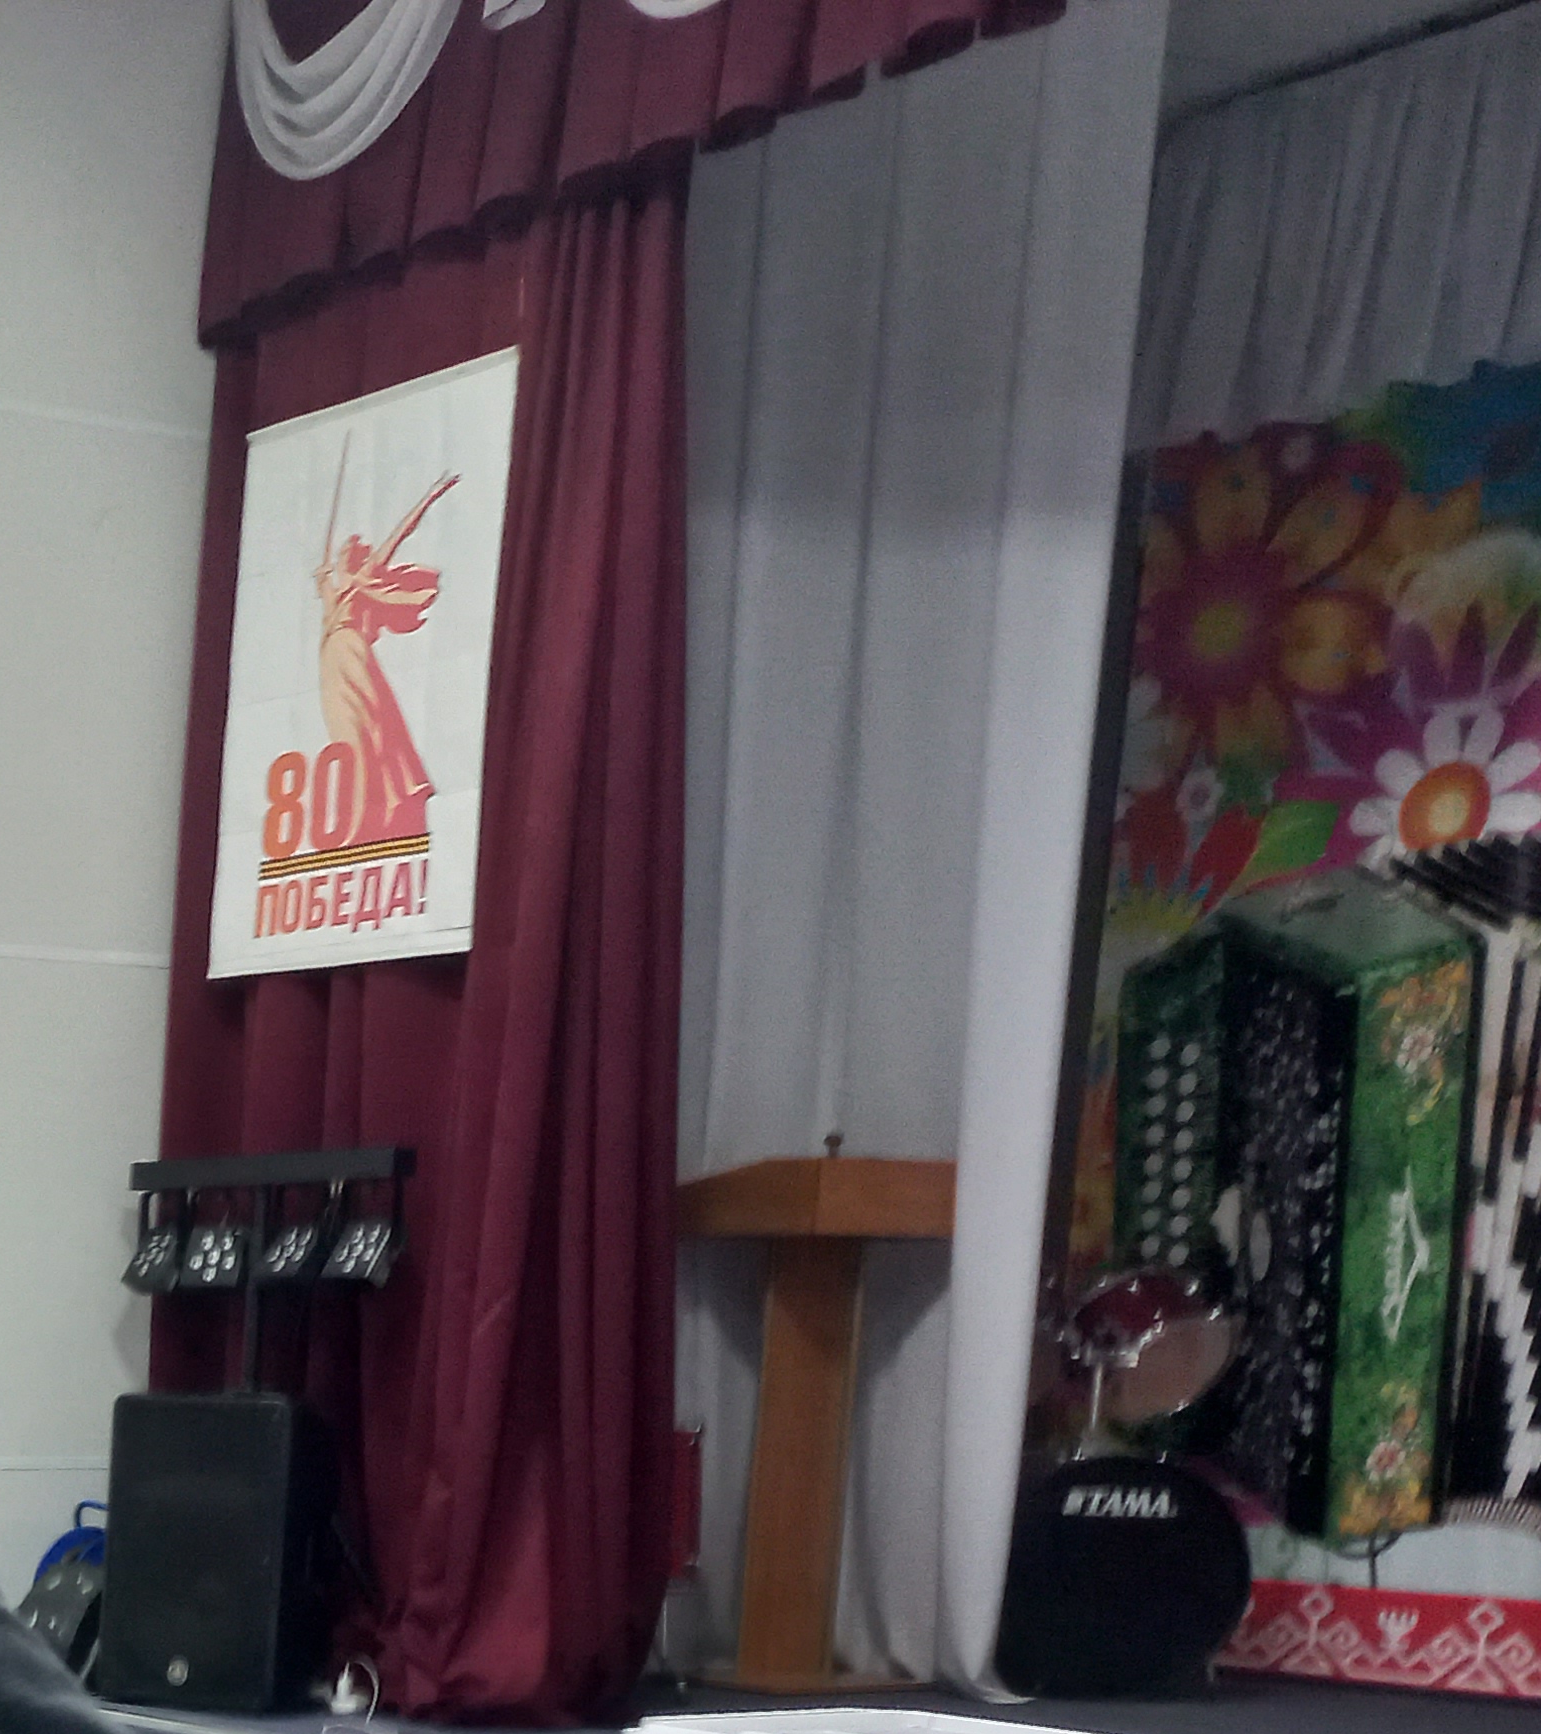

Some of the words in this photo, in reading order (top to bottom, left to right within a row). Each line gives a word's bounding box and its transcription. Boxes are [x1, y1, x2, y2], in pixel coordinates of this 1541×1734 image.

[263, 741, 355, 858] 80
[254, 859, 429, 938] ПОБЕДА!
[1085, 1487, 1173, 1518] TAMA
